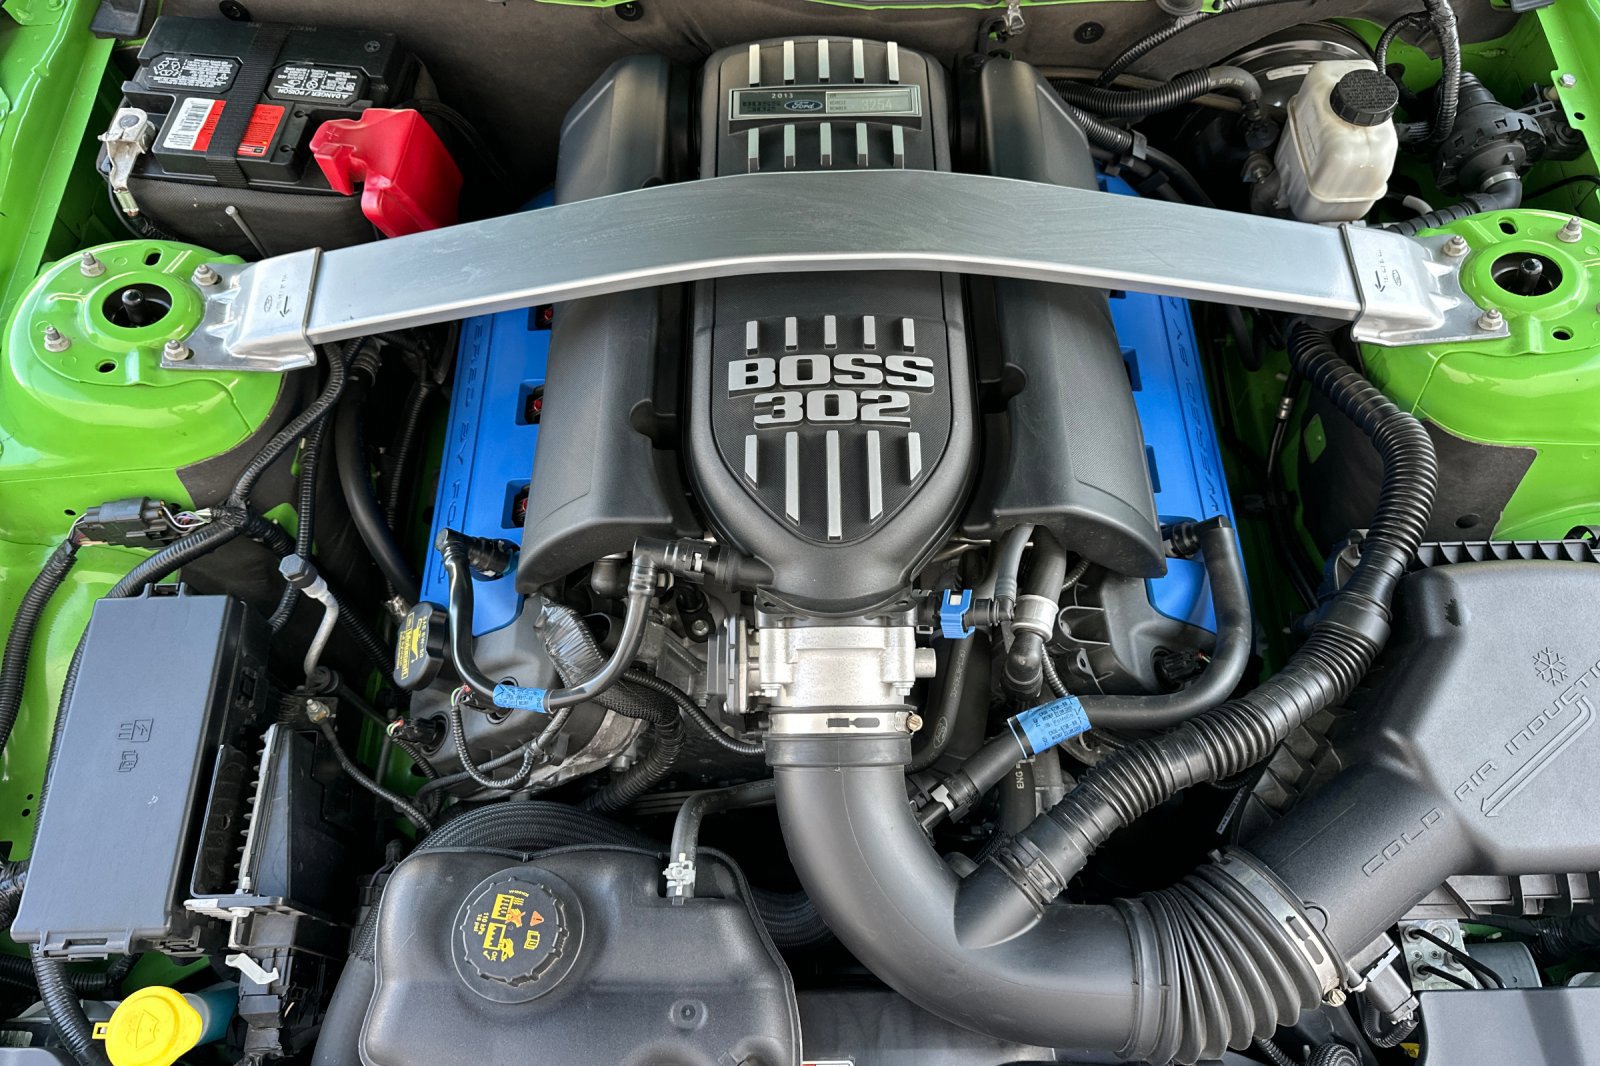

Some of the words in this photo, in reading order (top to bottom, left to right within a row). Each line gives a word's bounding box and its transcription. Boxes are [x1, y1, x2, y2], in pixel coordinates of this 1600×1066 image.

[277, 88, 304, 96] POISON
[311, 91, 342, 99] DANGER
[789, 101, 818, 110] Ford
[728, 354, 935, 393] BOSS
[753, 390, 911, 428] 302
[1361, 807, 1445, 877] COLD
[1453, 760, 1499, 802] AIR
[1503, 659, 1600, 756] INDUCTI
[1016, 771, 1025, 789] ENG
[481, 912, 489, 923] 110
[490, 951, 498, 962] OK
